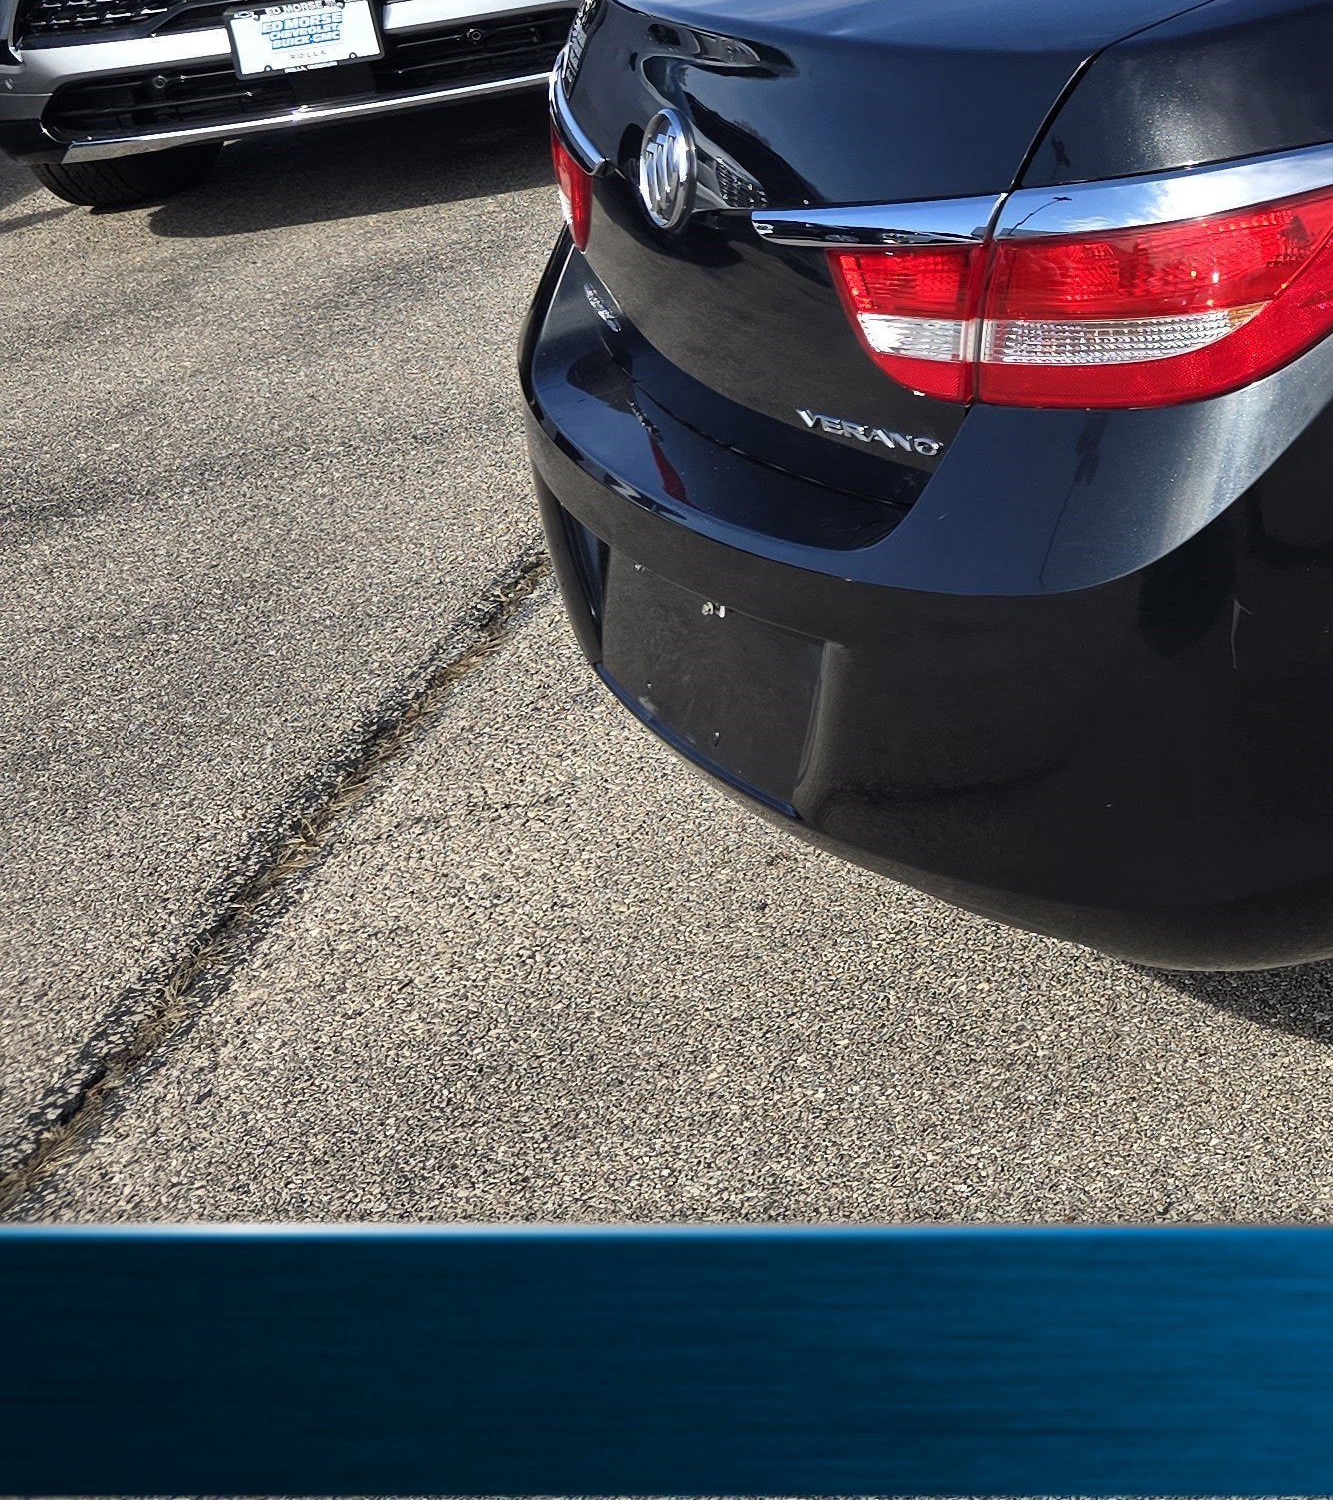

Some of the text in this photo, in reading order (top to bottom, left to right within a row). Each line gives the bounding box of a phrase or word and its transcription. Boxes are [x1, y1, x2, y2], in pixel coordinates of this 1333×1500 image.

[265, 6, 281, 16] ED
[283, 0, 323, 12] MORSE
[262, 11, 342, 34] ED MORSE
[269, 25, 340, 41] CHEVROLET
[290, 50, 326, 59] ROLLA
[796, 409, 944, 456] VERANO
